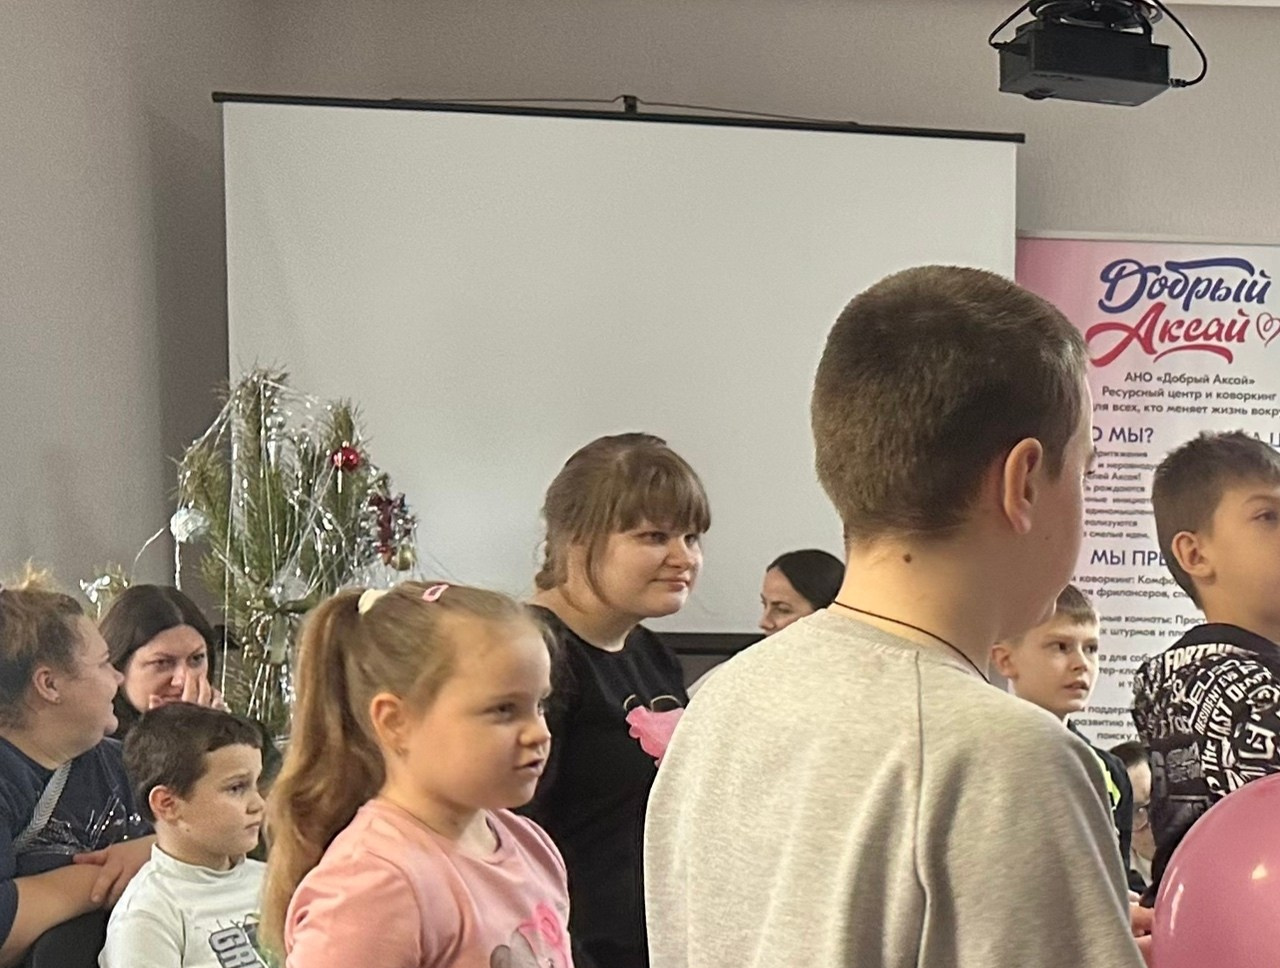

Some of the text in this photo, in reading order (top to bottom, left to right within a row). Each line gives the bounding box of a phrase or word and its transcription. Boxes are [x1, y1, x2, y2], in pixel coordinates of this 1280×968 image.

[1098, 257, 1272, 314] Добрый
[1085, 301, 1251, 368] Аксай
[1124, 371, 1153, 382] АНО
[1156, 371, 1210, 386] «Добрый
[1102, 385, 1277, 403] Ресурсный центр и коворкинг
[1092, 403, 1109, 412] ля
[1112, 403, 1141, 413] всех,
[1143, 404, 1164, 412] кто
[1166, 405, 1208, 413] меняет
[1211, 406, 1248, 415] жизнь
[1108, 426, 1154, 443] МЫ?
[1090, 549, 1126, 565] МЫ
[1096, 587, 1170, 599] фрилансеров,
[1110, 628, 1156, 638] штурмов
[1109, 654, 1127, 663] для
